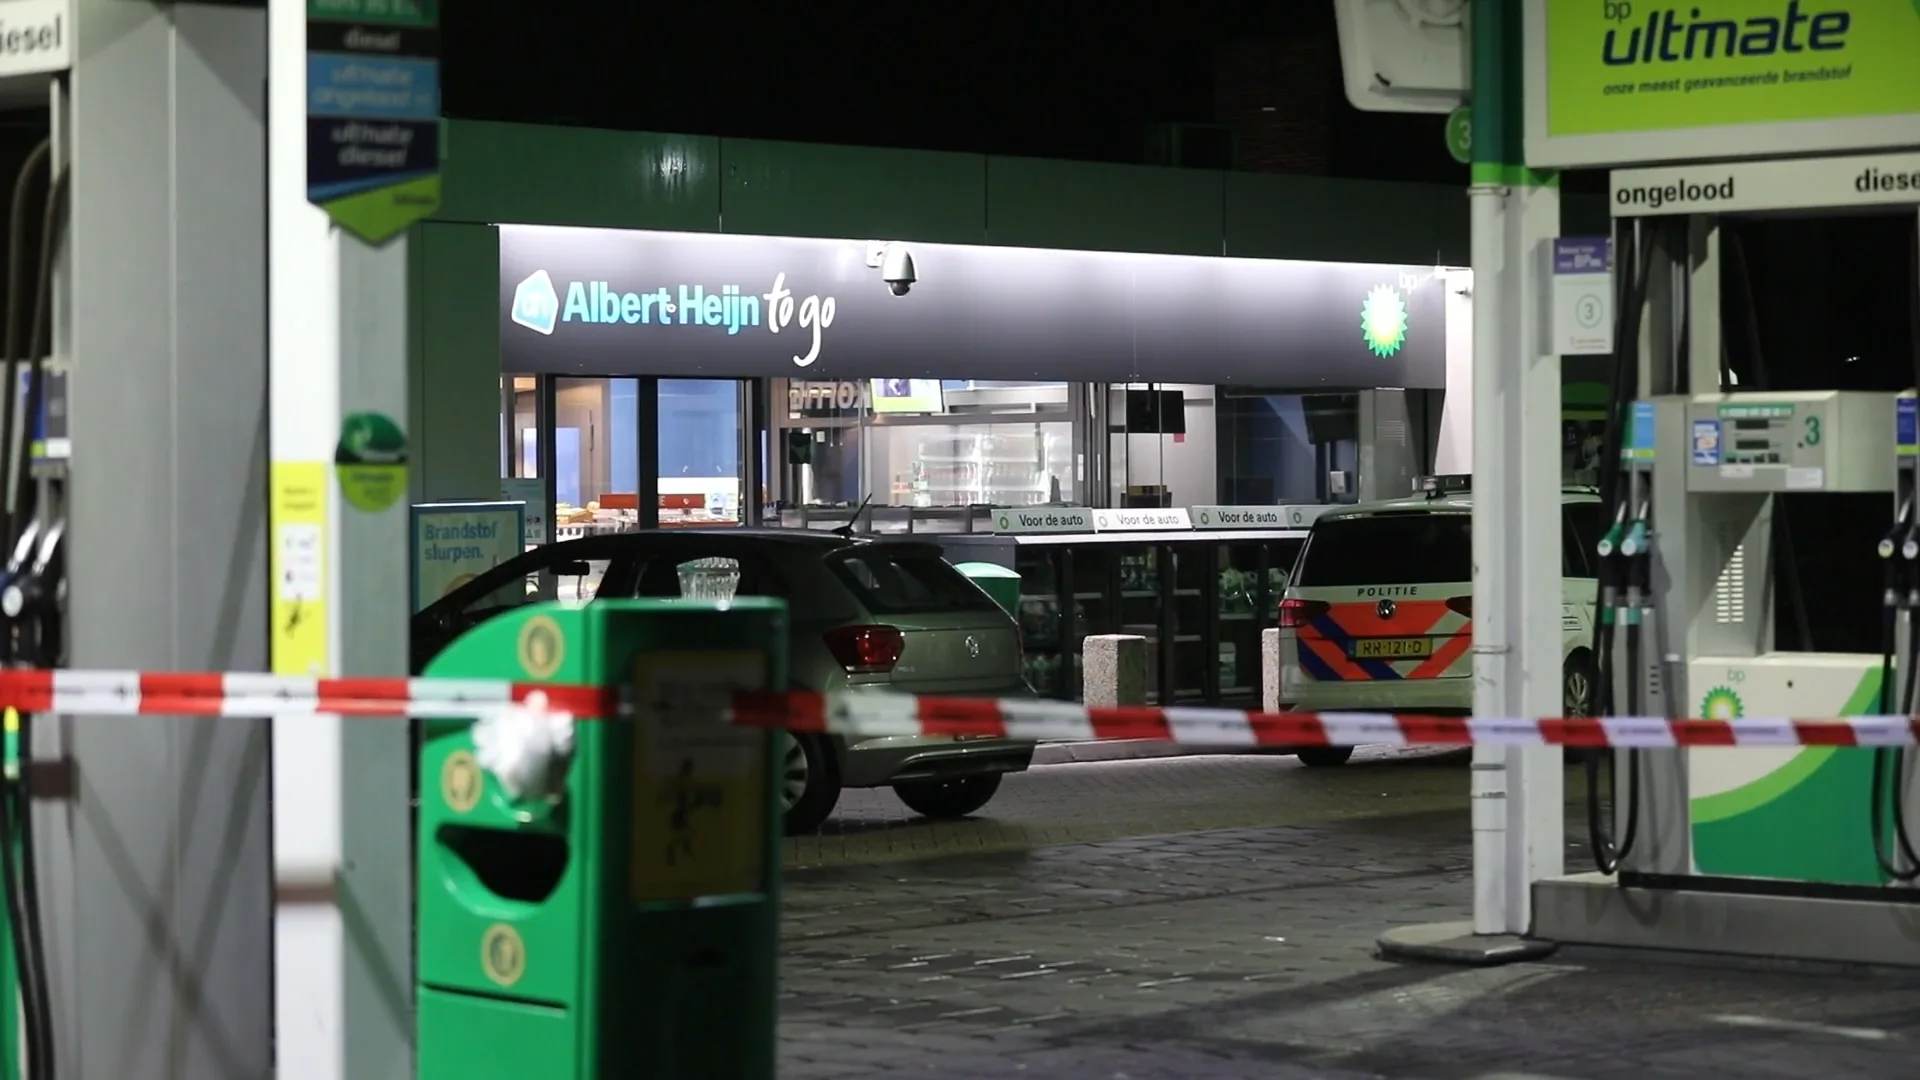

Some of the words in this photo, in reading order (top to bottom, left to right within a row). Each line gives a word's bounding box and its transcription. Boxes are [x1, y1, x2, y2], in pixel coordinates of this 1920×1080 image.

[1603, 0, 1632, 23] bp
[1602, 0, 1851, 66] ultimate
[1603, 78, 1636, 95] onze
[1638, 77, 1681, 93] meest
[1684, 71, 1779, 93] geavanceerde
[1783, 65, 1853, 84] brandstof
[1458, 120, 1472, 150] 3
[1855, 168, 1920, 193] diese
[1616, 176, 1735, 209] ongelood
[562, 281, 671, 325] Albert
[679, 284, 759, 334] Heijn
[1584, 302, 1595, 321] 3
[763, 272, 792, 333] to
[793, 294, 836, 367] go
[1804, 415, 1821, 447] 3
[1019, 513, 1045, 528] Voor
[1046, 512, 1058, 527] de
[1060, 513, 1084, 527] auto
[1116, 513, 1143, 527] Voor
[1144, 512, 1156, 526] de
[1157, 512, 1180, 525] auto
[1217, 510, 1240, 525] Voor
[1241, 510, 1254, 524] de
[1255, 510, 1278, 524] auto
[424, 521, 499, 540] Brandstof
[424, 543, 485, 563] slurpen.
[1357, 586, 1418, 598] POLITIE
[1727, 667, 1746, 685] bp
